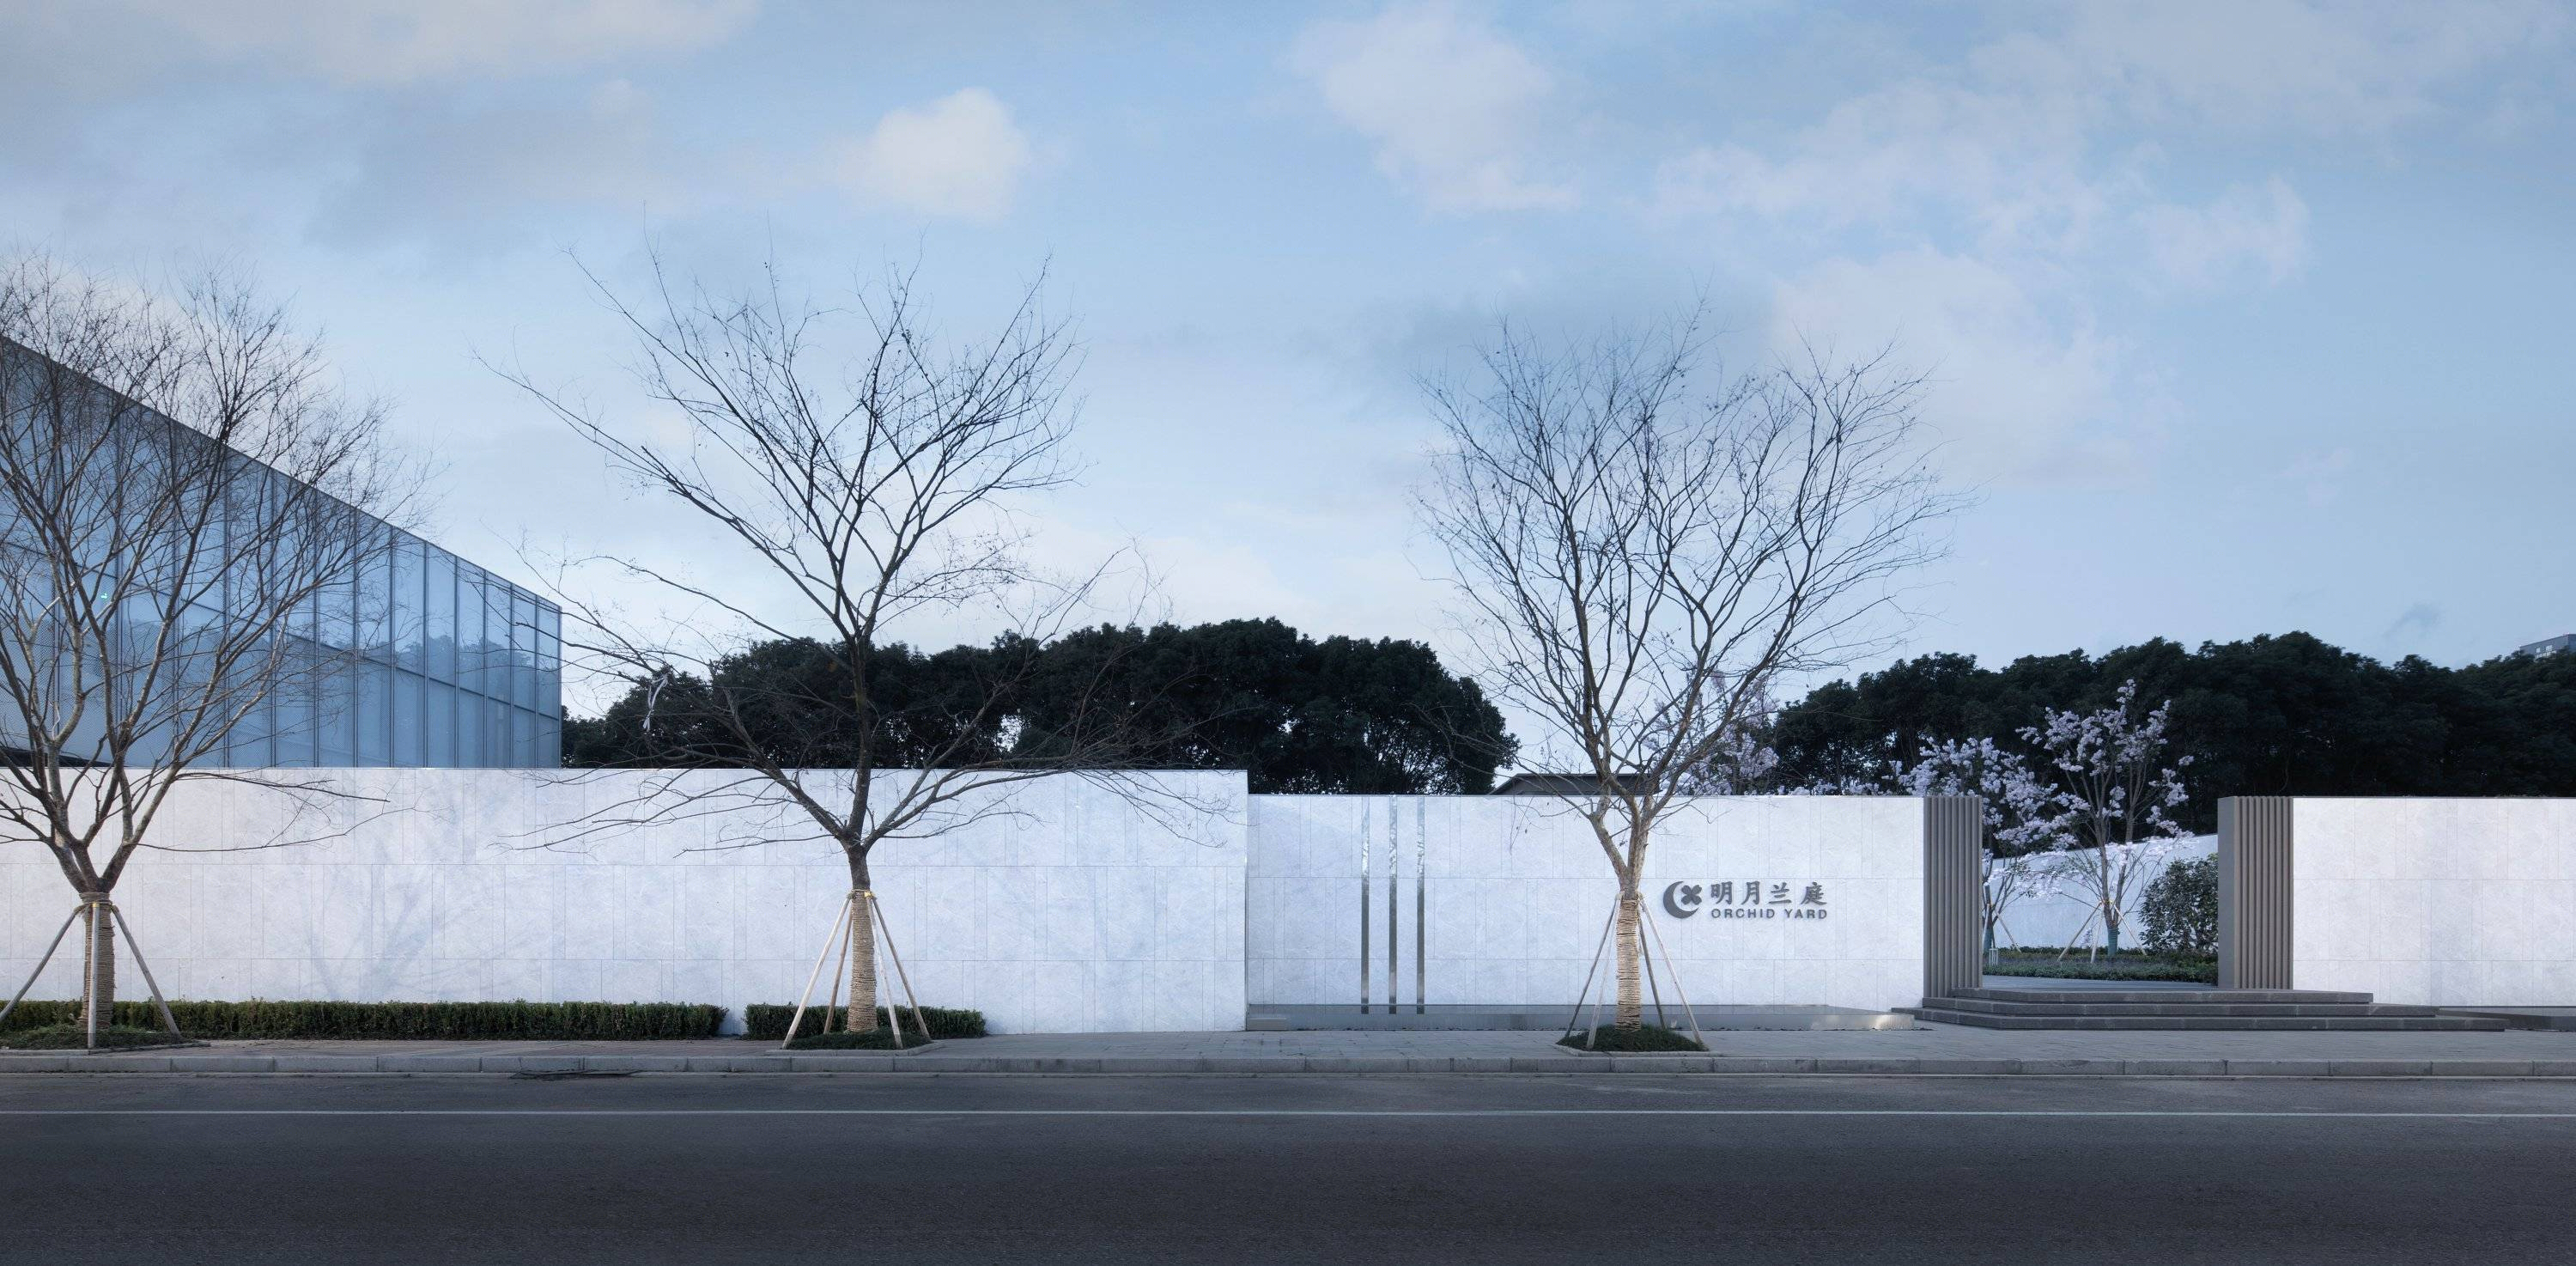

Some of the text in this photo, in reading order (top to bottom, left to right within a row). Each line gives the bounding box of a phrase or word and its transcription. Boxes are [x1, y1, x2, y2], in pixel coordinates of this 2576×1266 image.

[1710, 880, 1827, 906] 明月兰庭
[1710, 908, 1827, 920] ORCHID YARD
